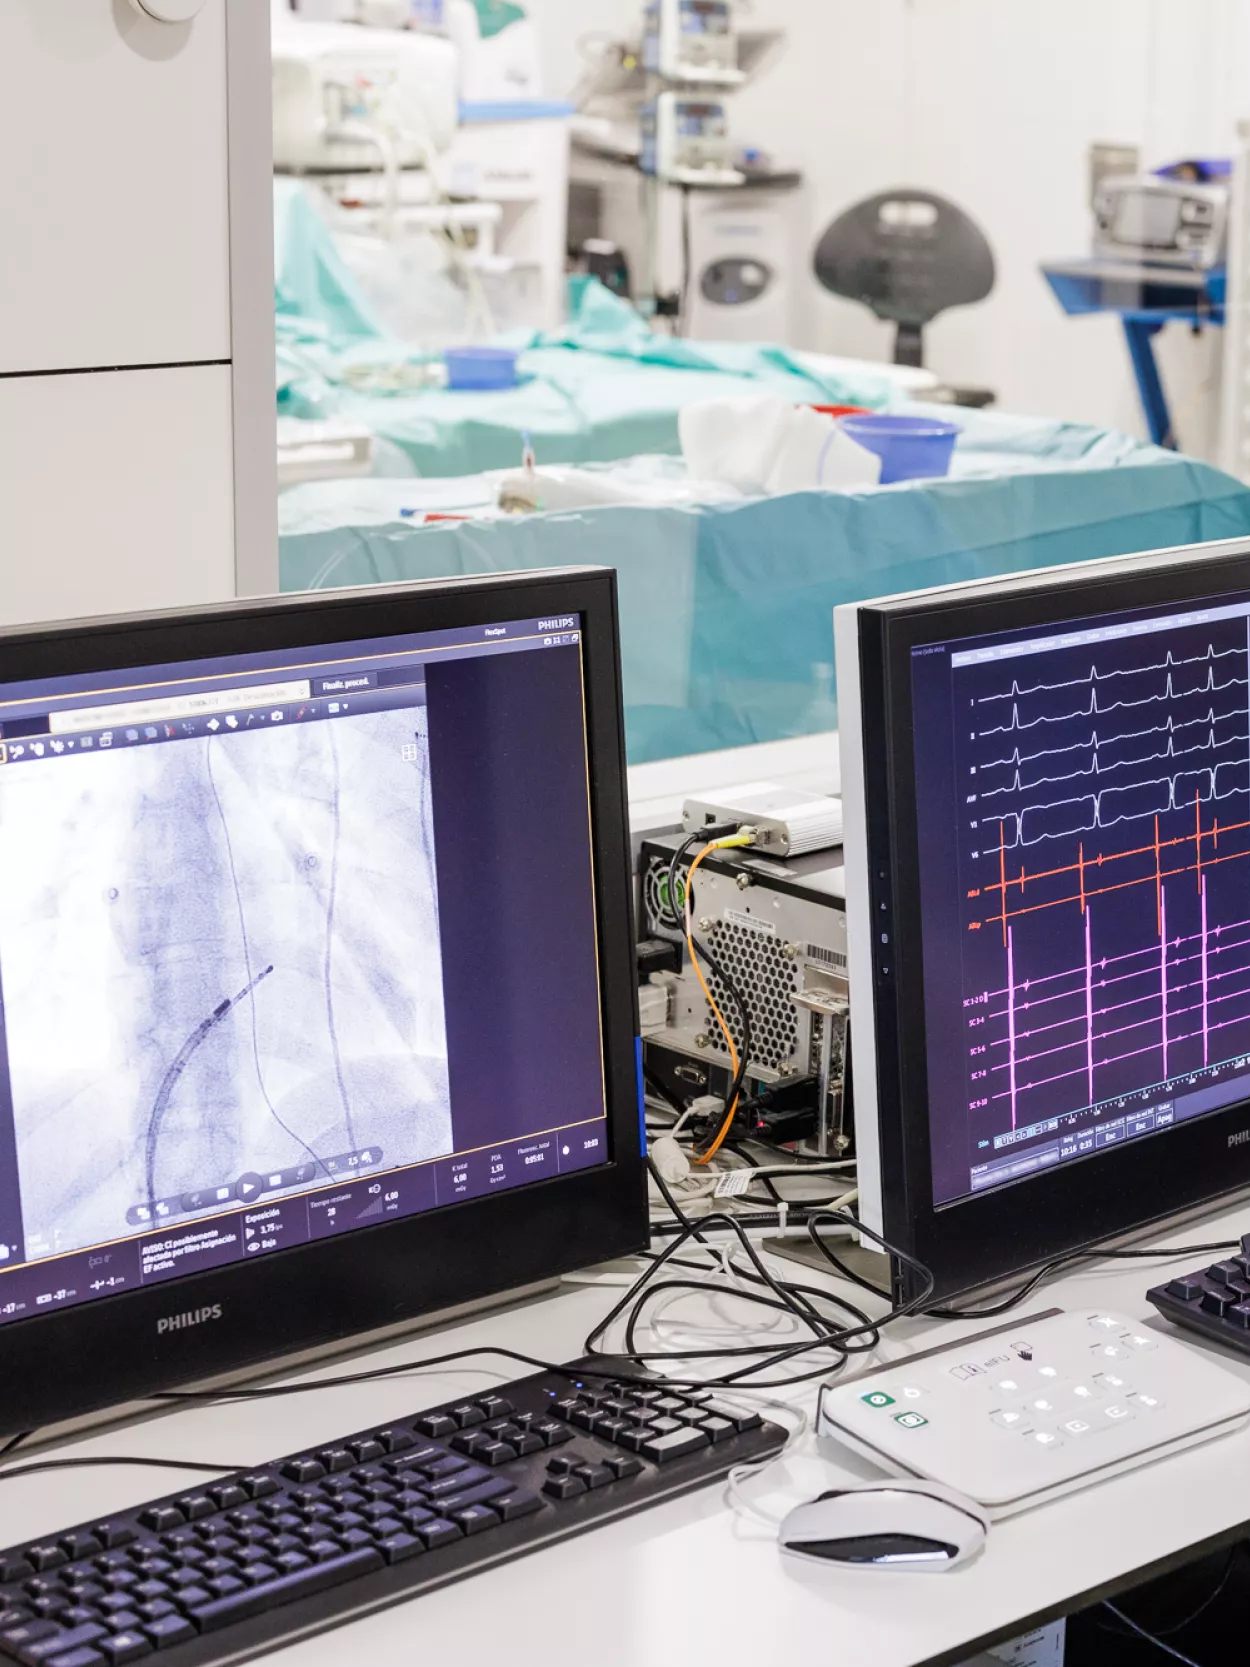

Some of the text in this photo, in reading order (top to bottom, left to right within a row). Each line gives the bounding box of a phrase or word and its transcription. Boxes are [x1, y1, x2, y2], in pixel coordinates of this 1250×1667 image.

[537, 617, 574, 631] PHILIPS
[310, 1193, 352, 1209] Tiempo restante
[244, 1208, 281, 1224] Exposición
[141, 1244, 164, 1256] AVISO:
[173, 1230, 219, 1249] posiblemente
[143, 1250, 172, 1264] afectada
[172, 1248, 185, 1258] por
[200, 1234, 237, 1250] Asignación
[261, 1239, 277, 1249] Baja
[157, 1303, 222, 1335] PHILIPS
